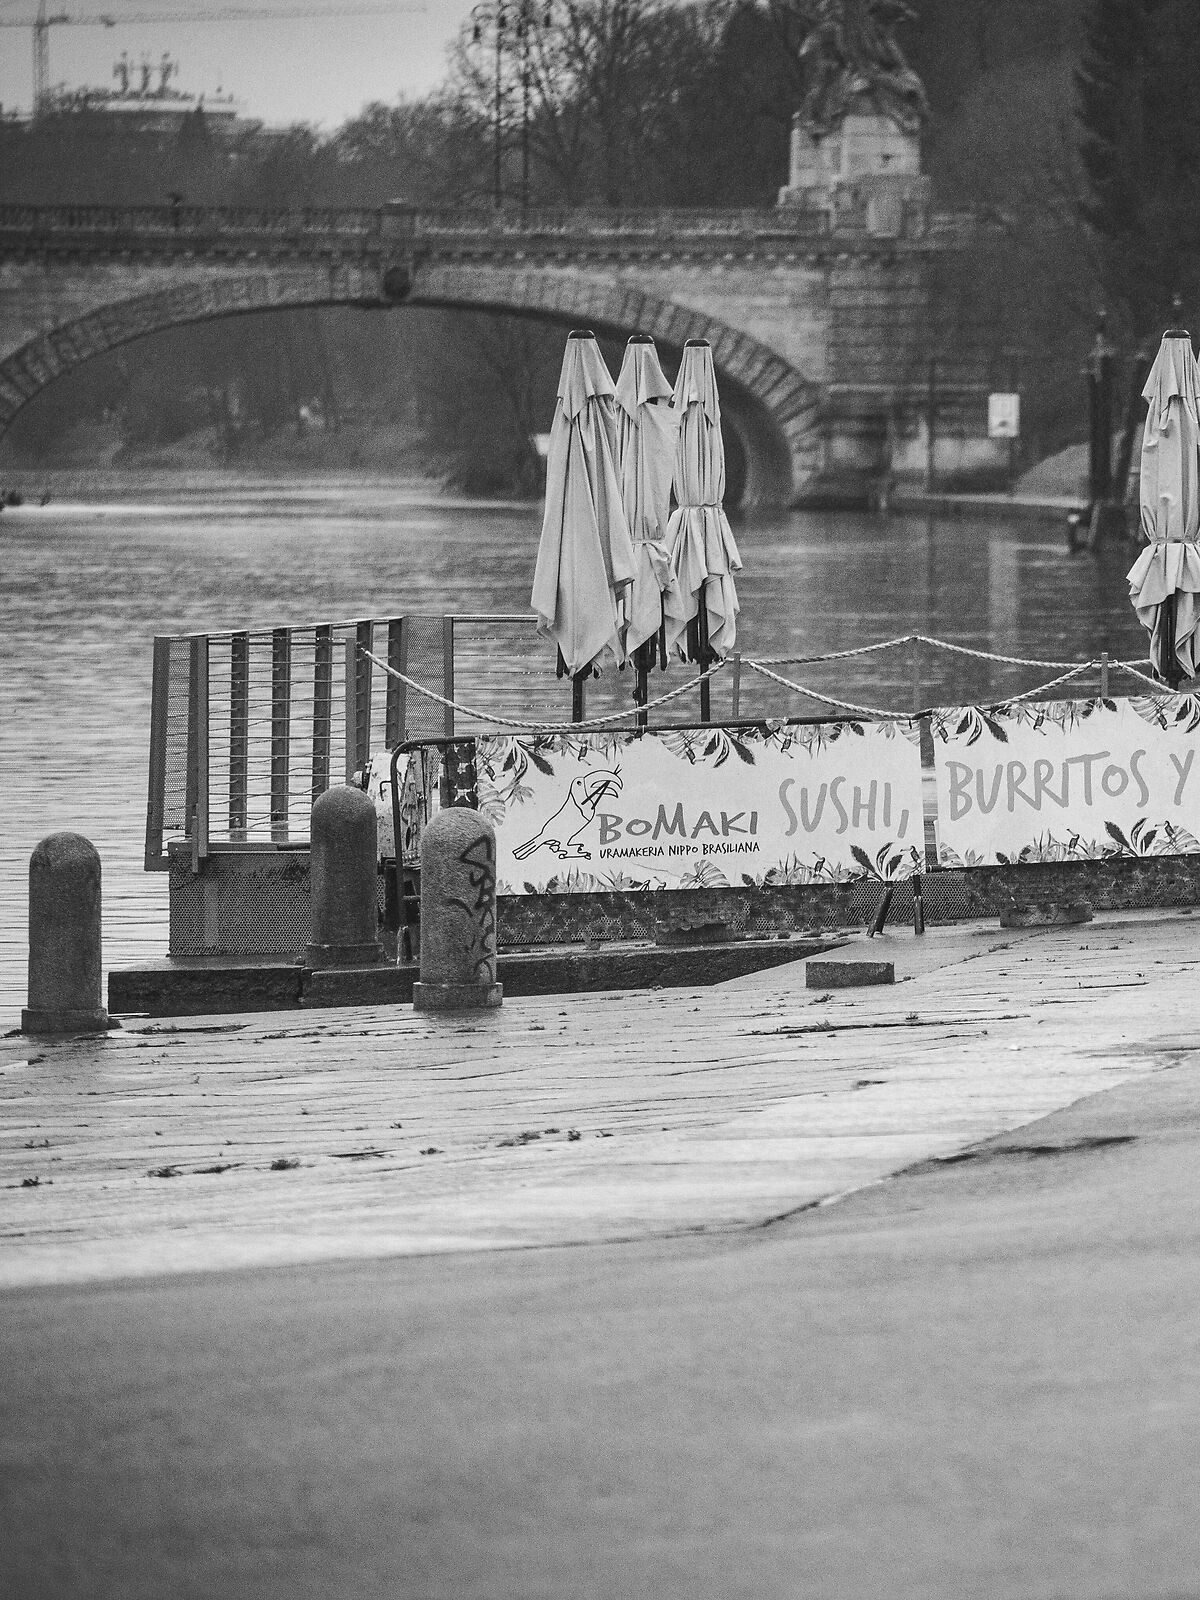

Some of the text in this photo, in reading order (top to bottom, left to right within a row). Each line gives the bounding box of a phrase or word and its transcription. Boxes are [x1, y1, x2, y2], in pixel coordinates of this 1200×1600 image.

[778, 775, 910, 839] SUSHI,
[944, 749, 1150, 822] BURRITOS
[1168, 749, 1196, 806] Y
[598, 803, 758, 845] BOMAKI
[599, 841, 761, 859] URAMAKERIA NIPPO BRASILIANA
